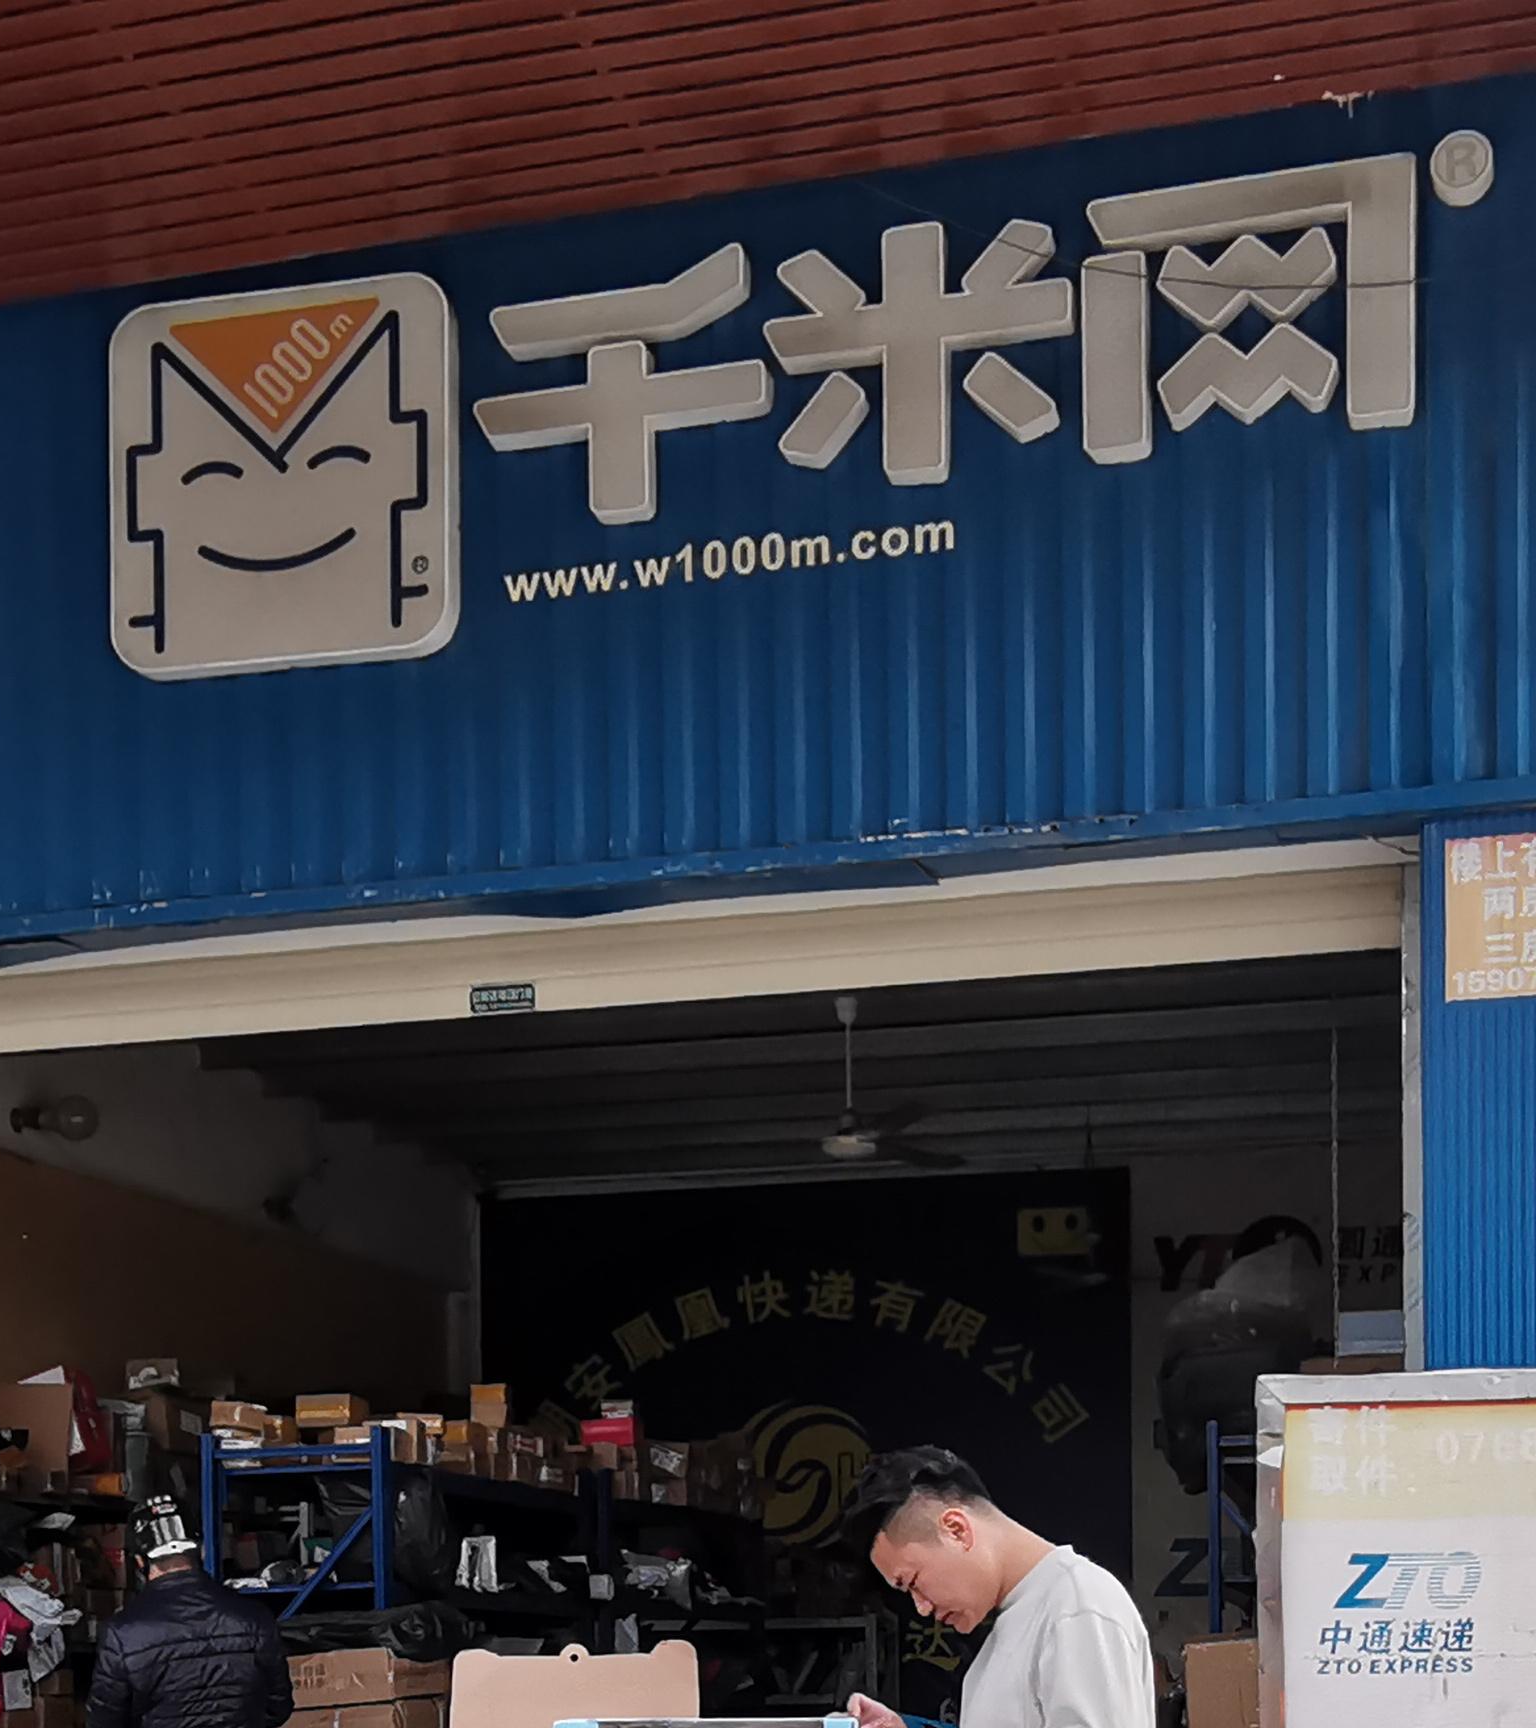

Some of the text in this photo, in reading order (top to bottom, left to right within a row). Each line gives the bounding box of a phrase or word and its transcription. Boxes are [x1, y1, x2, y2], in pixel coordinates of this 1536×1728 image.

[241, 310, 354, 420] 1000m
[473, 152, 1417, 527] 千米网
[504, 513, 958, 605] www.w1000m.com
[1333, 1552, 1482, 1609] ZTO
[1318, 1617, 1475, 1655] 中通速递
[1318, 1656, 1473, 1674] ZTO EXPRESS
